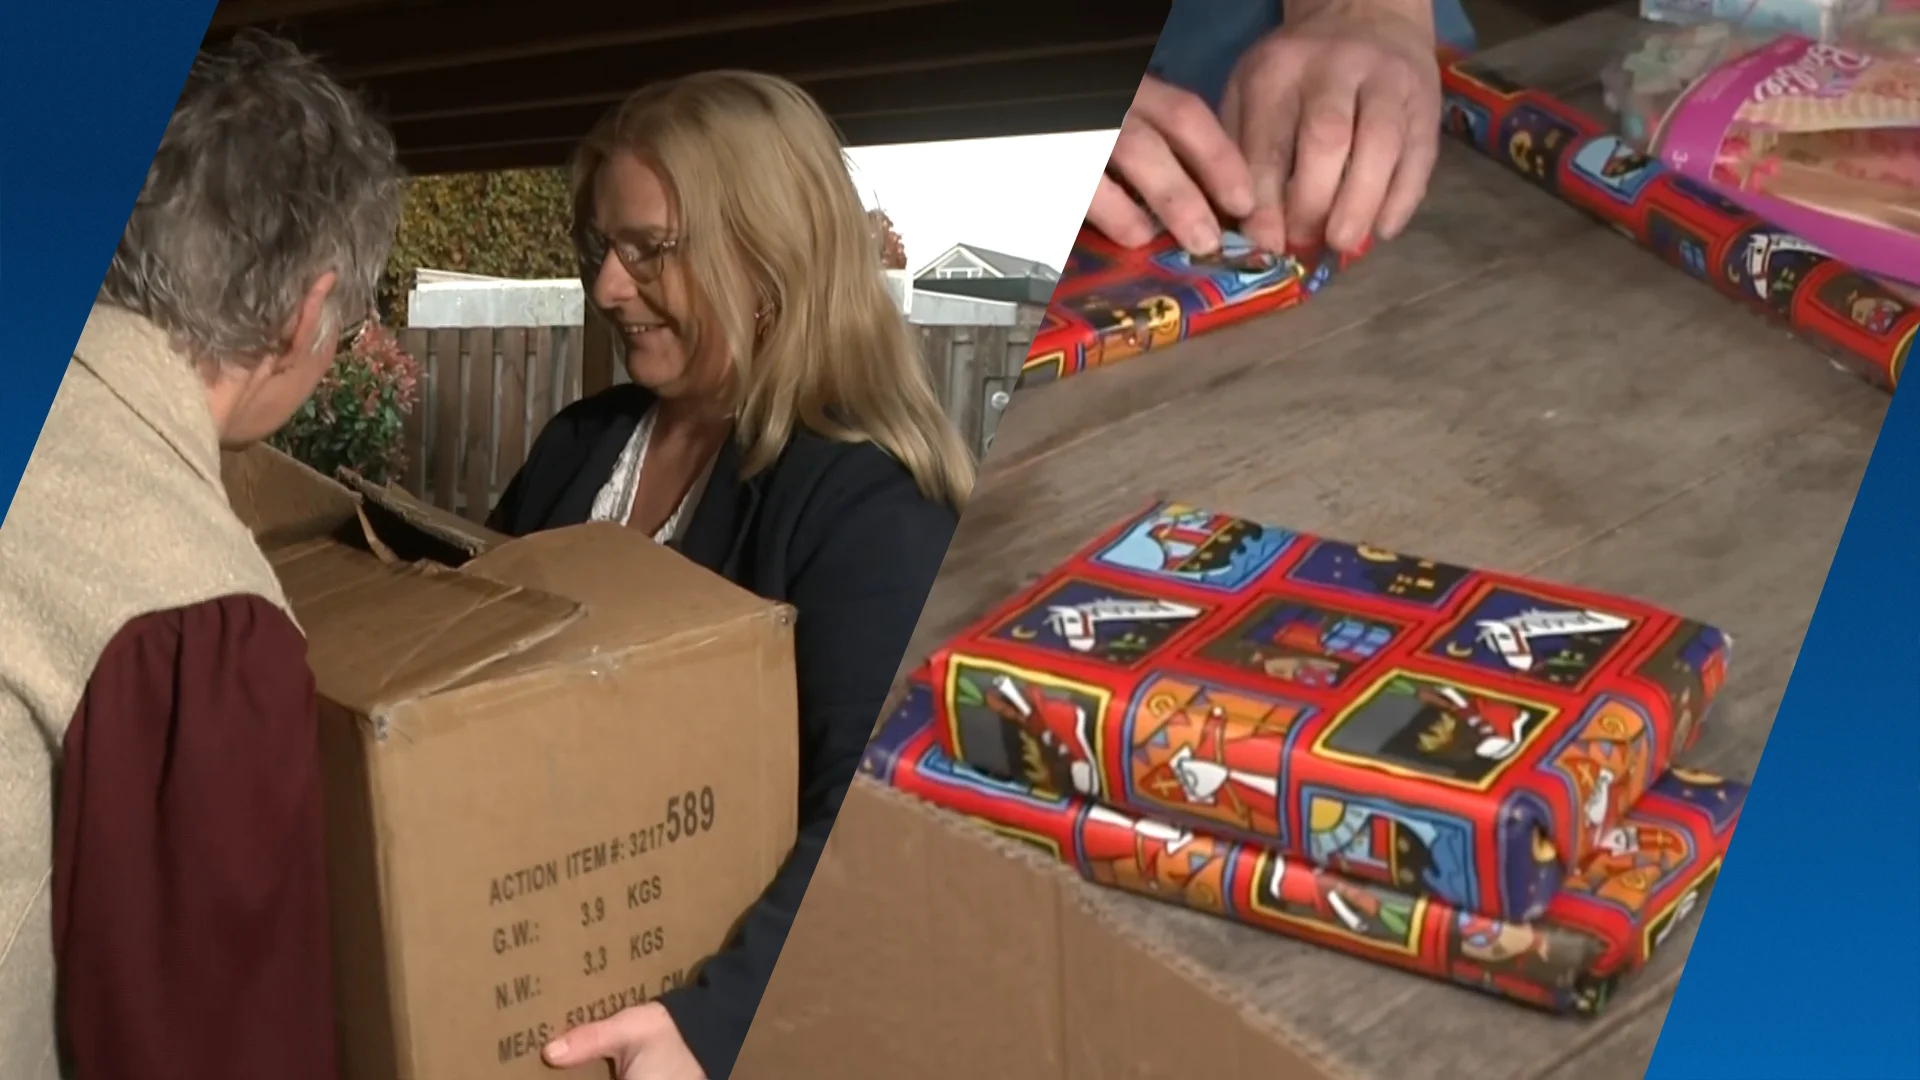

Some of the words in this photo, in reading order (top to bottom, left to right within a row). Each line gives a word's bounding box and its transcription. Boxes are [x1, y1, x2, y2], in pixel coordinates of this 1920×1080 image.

[489, 859, 558, 906] ACTION
[493, 919, 540, 955] G.W.:
[580, 896, 606, 927] 3.9
[627, 875, 662, 909] KGS
[494, 974, 542, 1010] N.W.:
[583, 946, 608, 976] 3.3
[630, 926, 665, 961] KGS
[498, 1021, 557, 1064] MEAS:
[661, 968, 686, 993] CM
